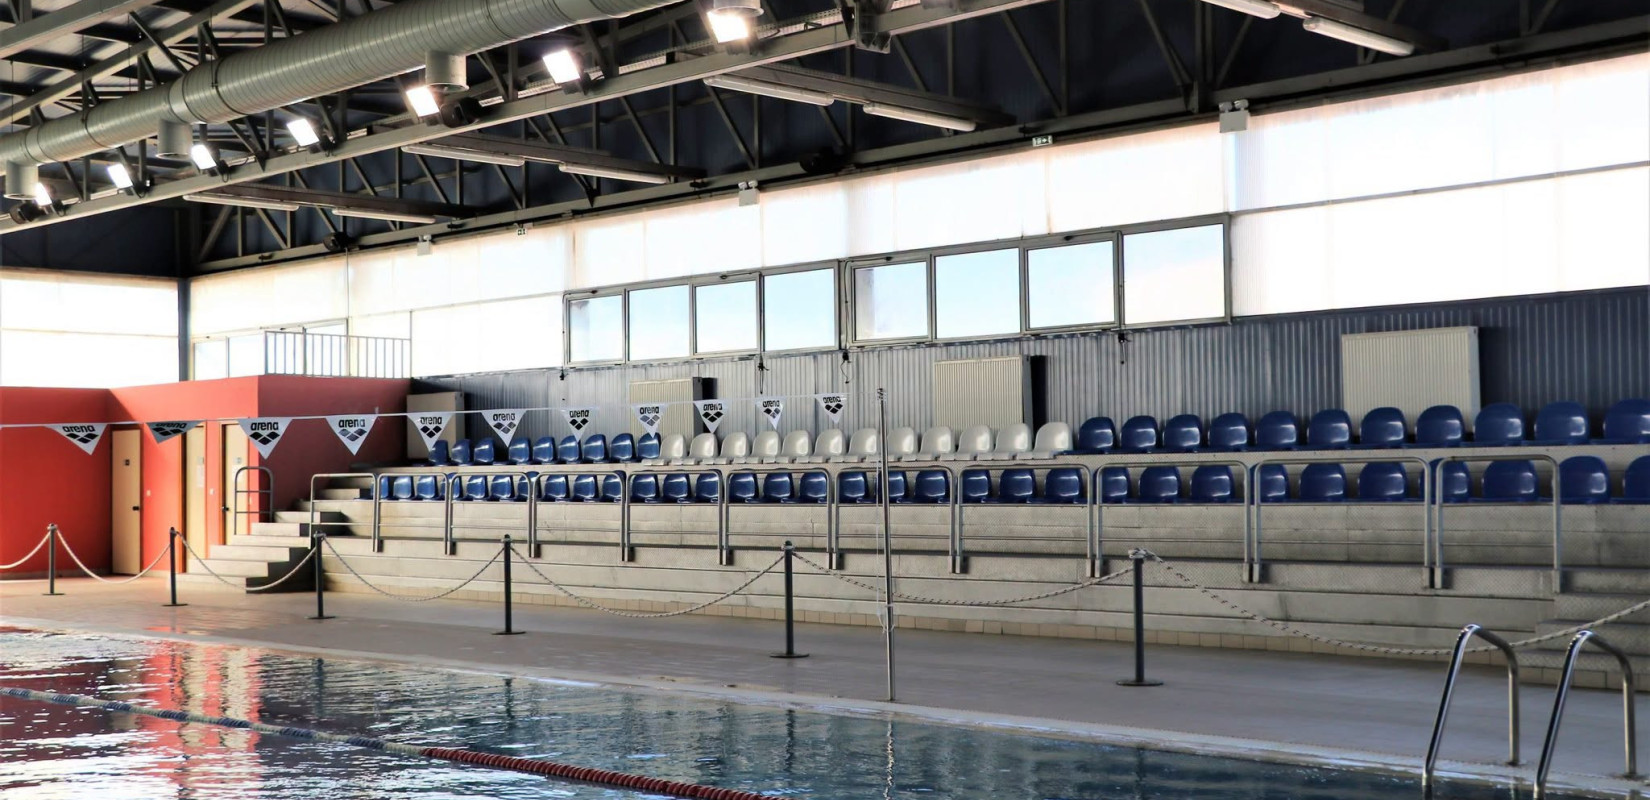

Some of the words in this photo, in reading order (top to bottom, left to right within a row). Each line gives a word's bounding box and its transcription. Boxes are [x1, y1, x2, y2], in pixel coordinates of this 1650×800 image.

[762, 400, 780, 408] arena
[823, 396, 842, 404] arena
[640, 406, 660, 415] arena
[703, 403, 723, 411] arena
[493, 412, 516, 422] arena
[569, 409, 590, 418] arena
[338, 419, 366, 428] arena
[420, 416, 442, 425] arena
[62, 424, 95, 433] arena
[250, 421, 279, 431] arena
